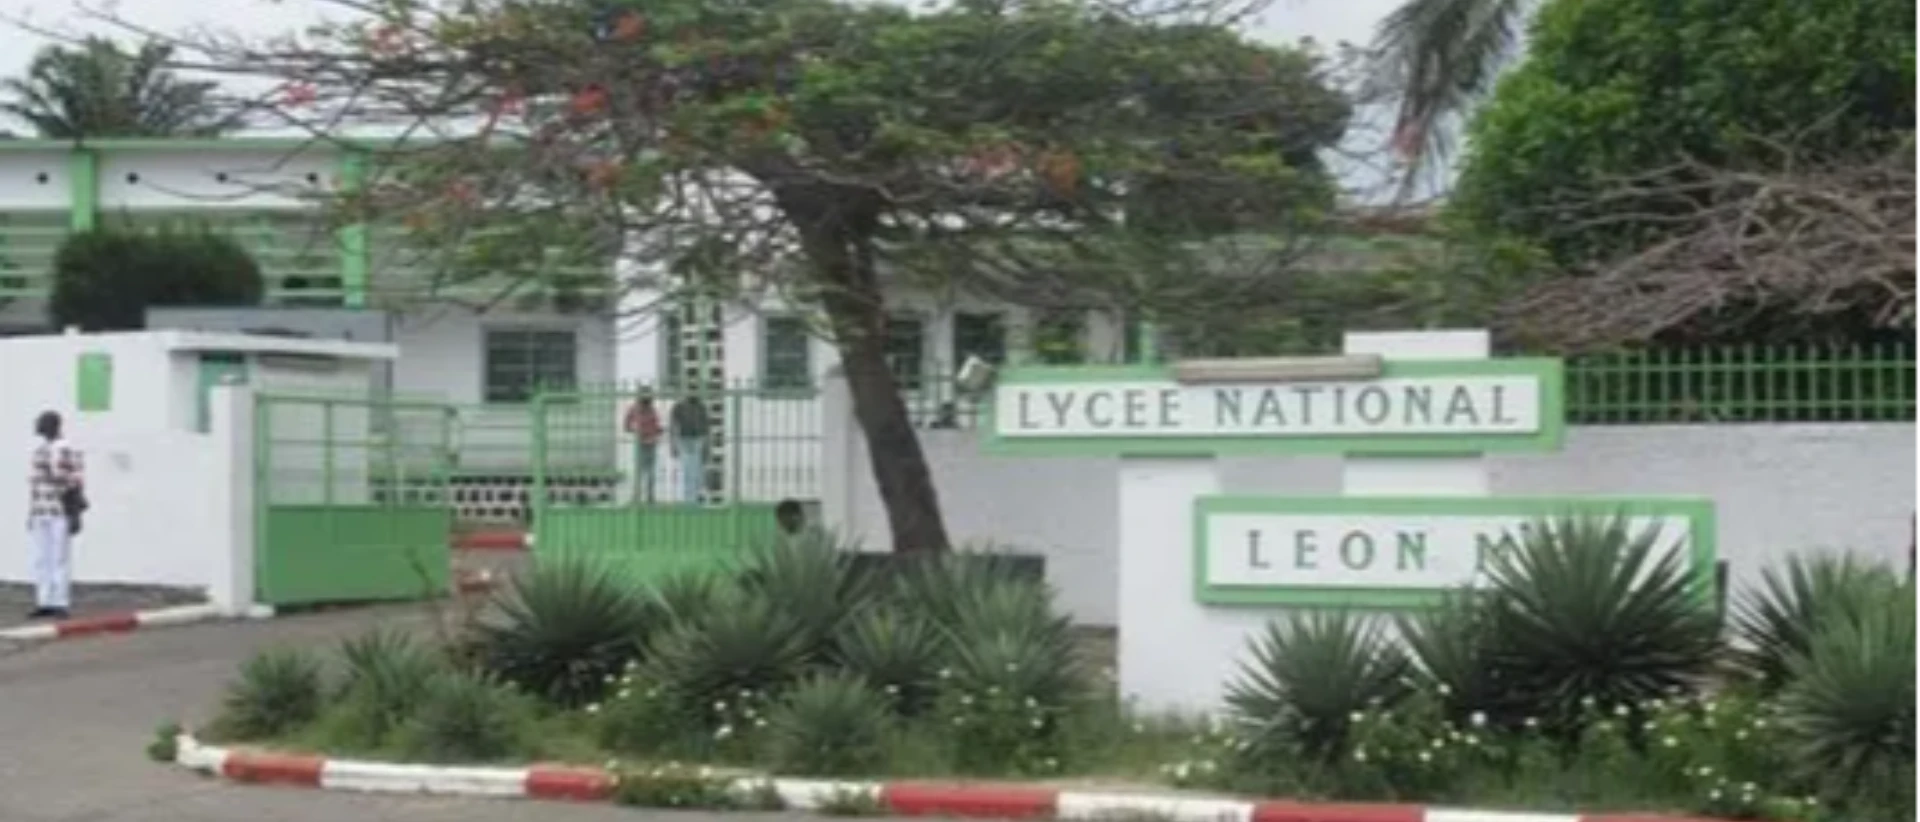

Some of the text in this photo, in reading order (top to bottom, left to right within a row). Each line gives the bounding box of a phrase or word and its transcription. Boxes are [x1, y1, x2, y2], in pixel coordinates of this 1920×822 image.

[1018, 385, 1519, 430] LYCEE NATIONAL
[1247, 529, 1427, 571] LEON
